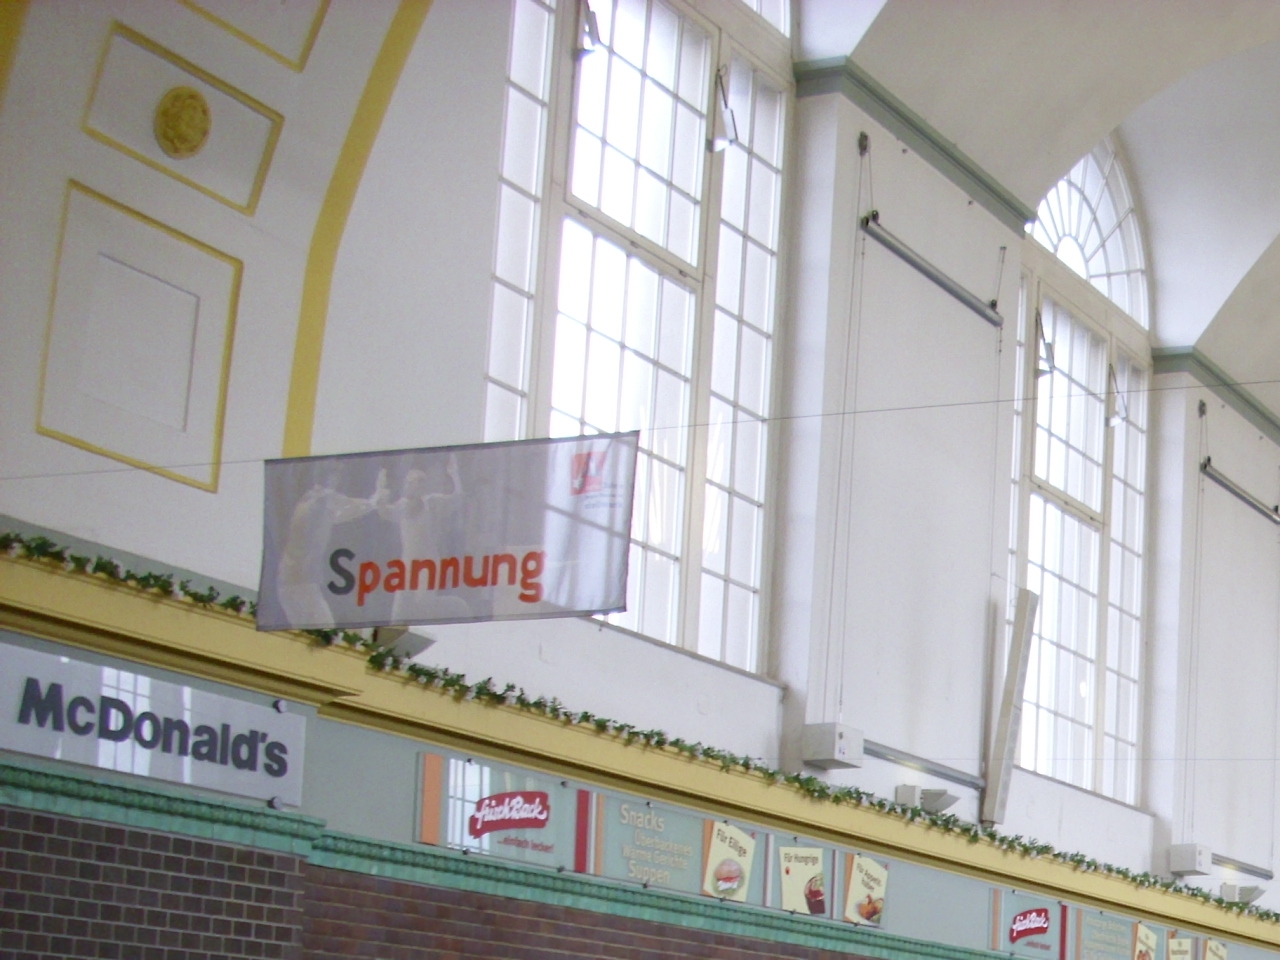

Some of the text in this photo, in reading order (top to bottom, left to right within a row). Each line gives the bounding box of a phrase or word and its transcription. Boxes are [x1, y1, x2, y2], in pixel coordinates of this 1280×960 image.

[327, 548, 546, 607] Spannung
[17, 676, 288, 778] McDonald's
[620, 803, 665, 832] Snacks
[622, 844, 652, 863] Warme
[716, 828, 747, 858] Für Eilige
[628, 860, 670, 883] Suppen
[784, 853, 819, 866] Für Hungrige
